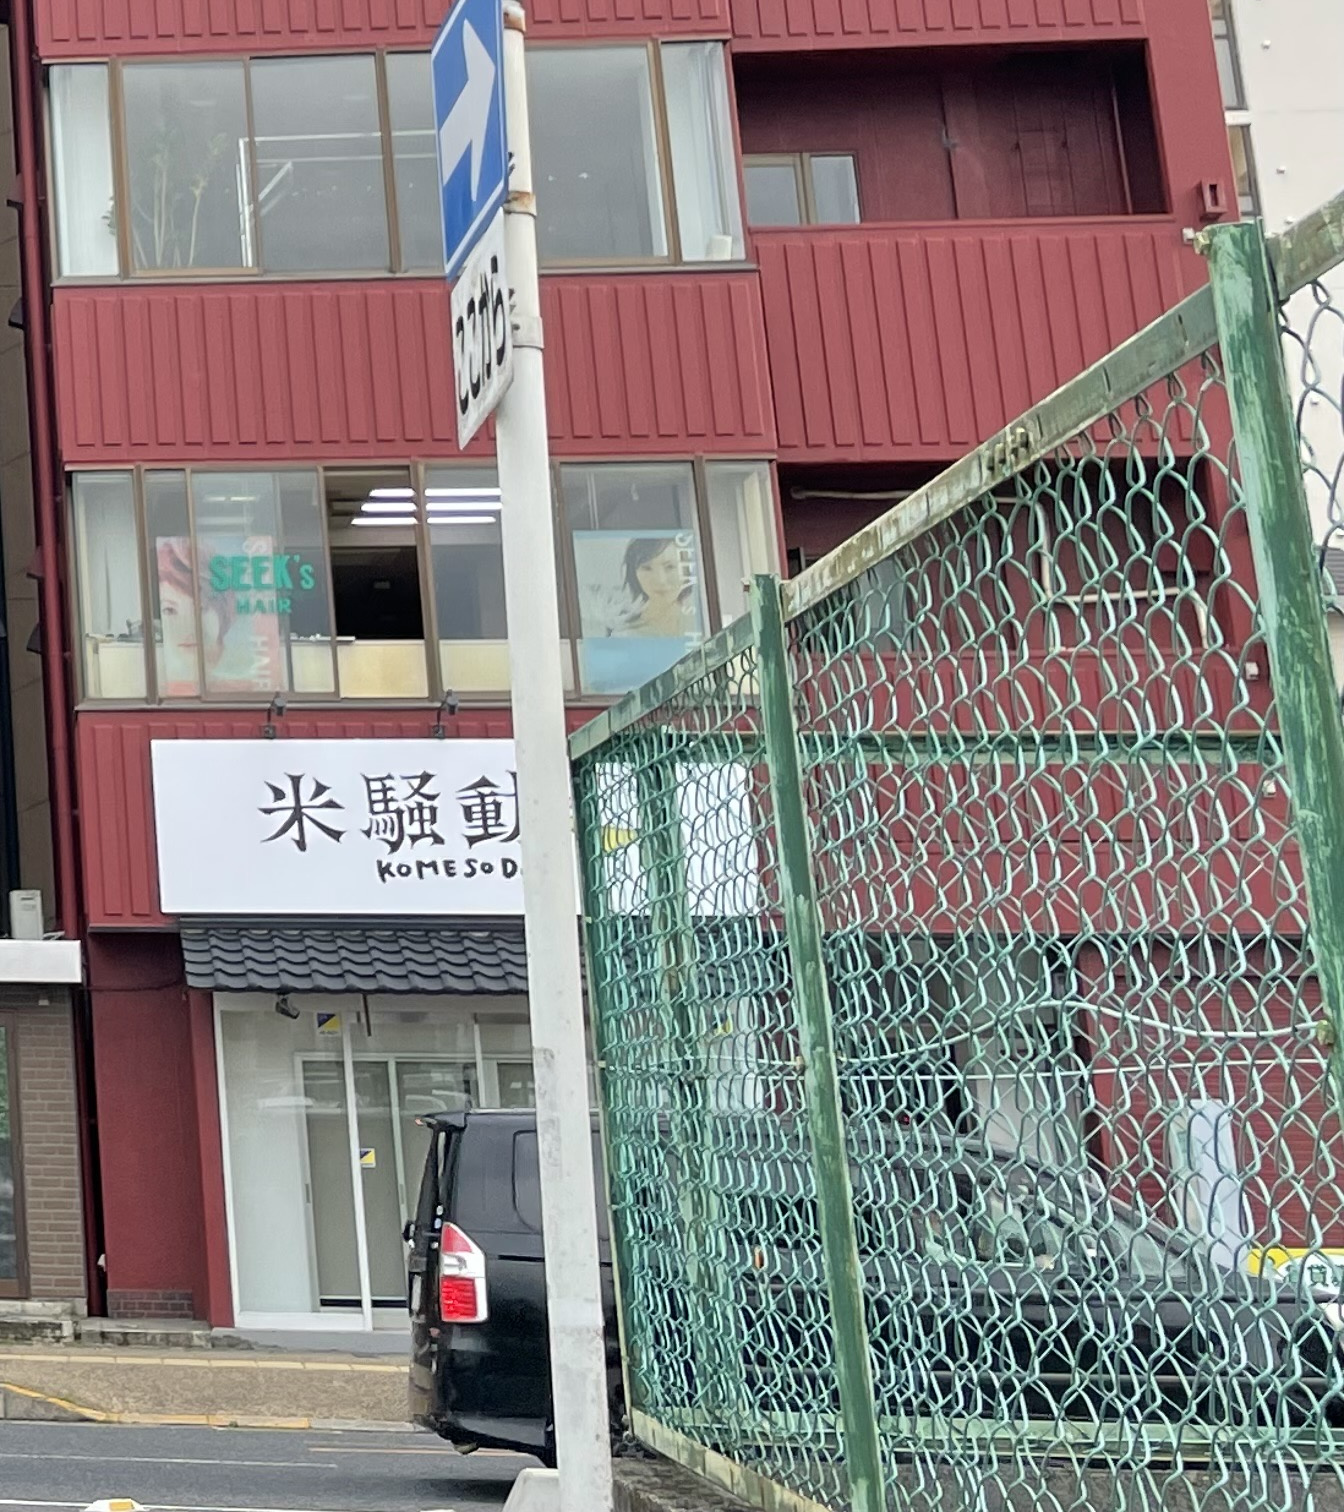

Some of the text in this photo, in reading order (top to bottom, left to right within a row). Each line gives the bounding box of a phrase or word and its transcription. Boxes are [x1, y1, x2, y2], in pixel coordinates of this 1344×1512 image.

[456, 254, 507, 415] ここから
[236, 596, 292, 615] HAIR
[375, 857, 521, 884] KOMESOD
